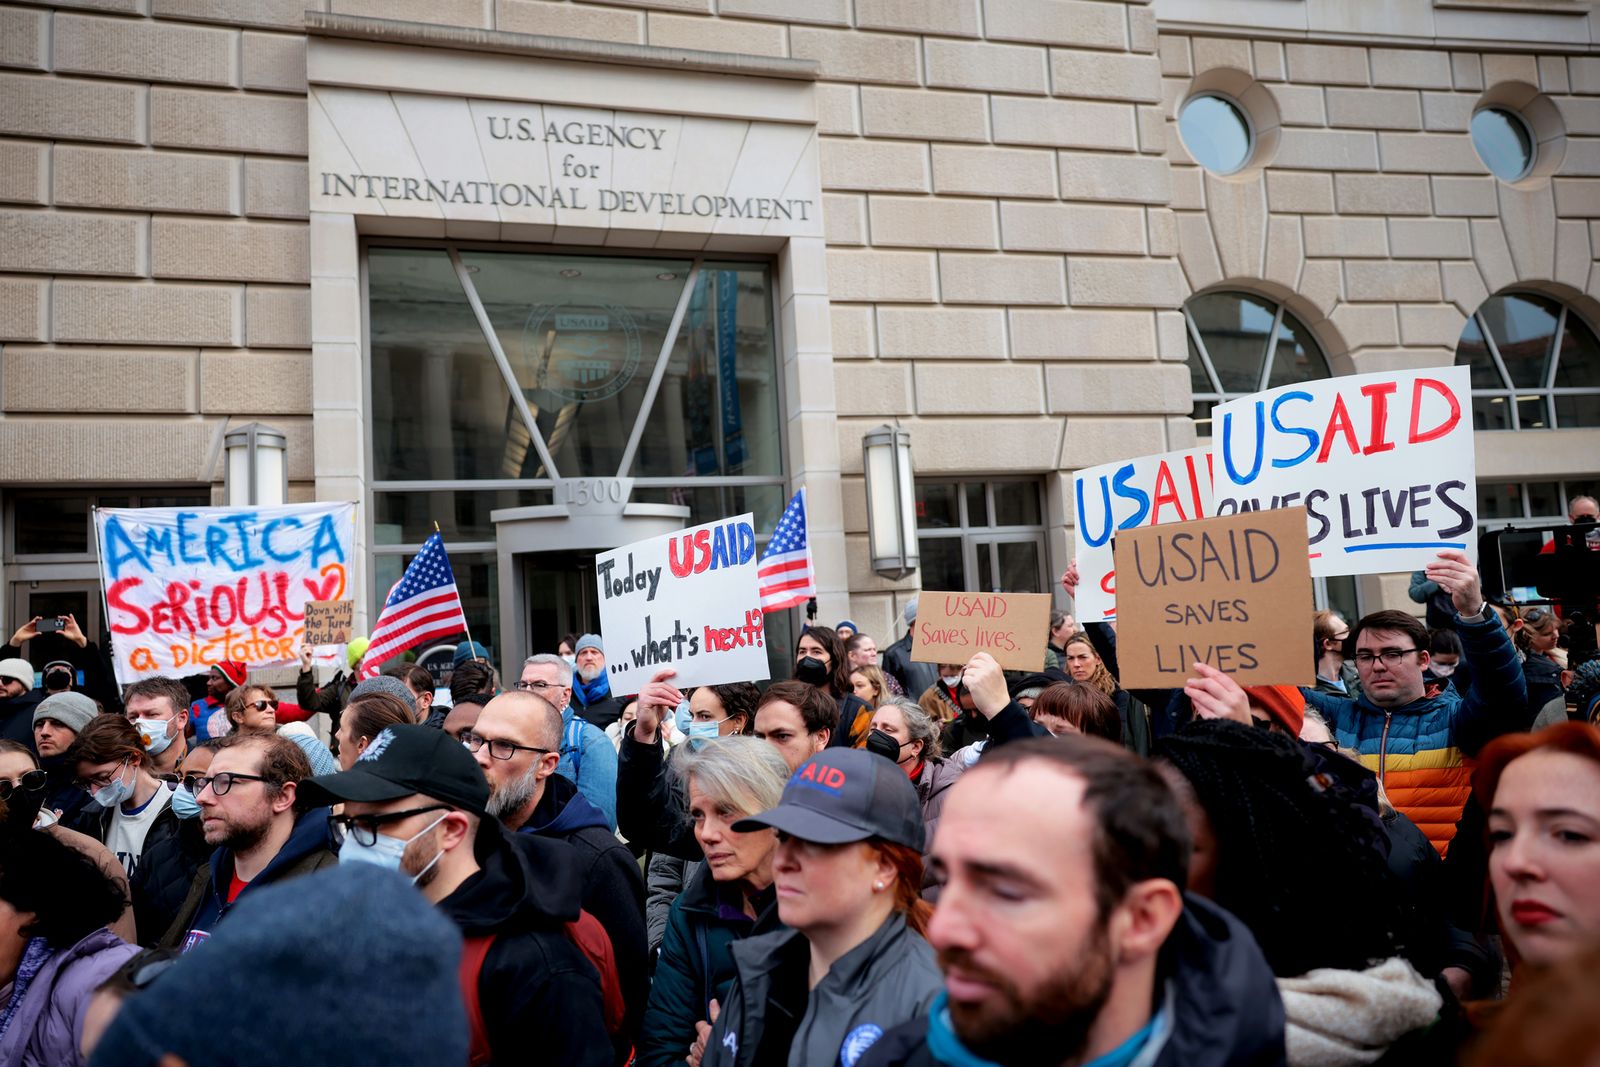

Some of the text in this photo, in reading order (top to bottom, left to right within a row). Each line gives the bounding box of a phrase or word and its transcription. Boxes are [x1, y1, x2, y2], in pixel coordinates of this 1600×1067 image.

[487, 116, 667, 151] U.S. AGENCY
[562, 153, 600, 179] for
[320, 172, 813, 222] INTERNATIONAL DEVELOPMENT
[560, 319, 605, 328] USAID
[1223, 378, 1462, 486] USAID
[565, 479, 622, 506] 1300
[1076, 453, 1215, 548] USAI
[1341, 480, 1474, 540] LIVES
[597, 522, 756, 602] Today USAID
[1133, 528, 1280, 588] USAID
[305, 601, 353, 616] Down with
[945, 595, 1007, 618] USAID
[1165, 599, 1250, 626] SAVES
[304, 614, 352, 629] the Turd
[305, 631, 333, 645] Reich
[975, 625, 1021, 652] lives.
[129, 647, 158, 672] a
[1155, 644, 1259, 674] LIVES
